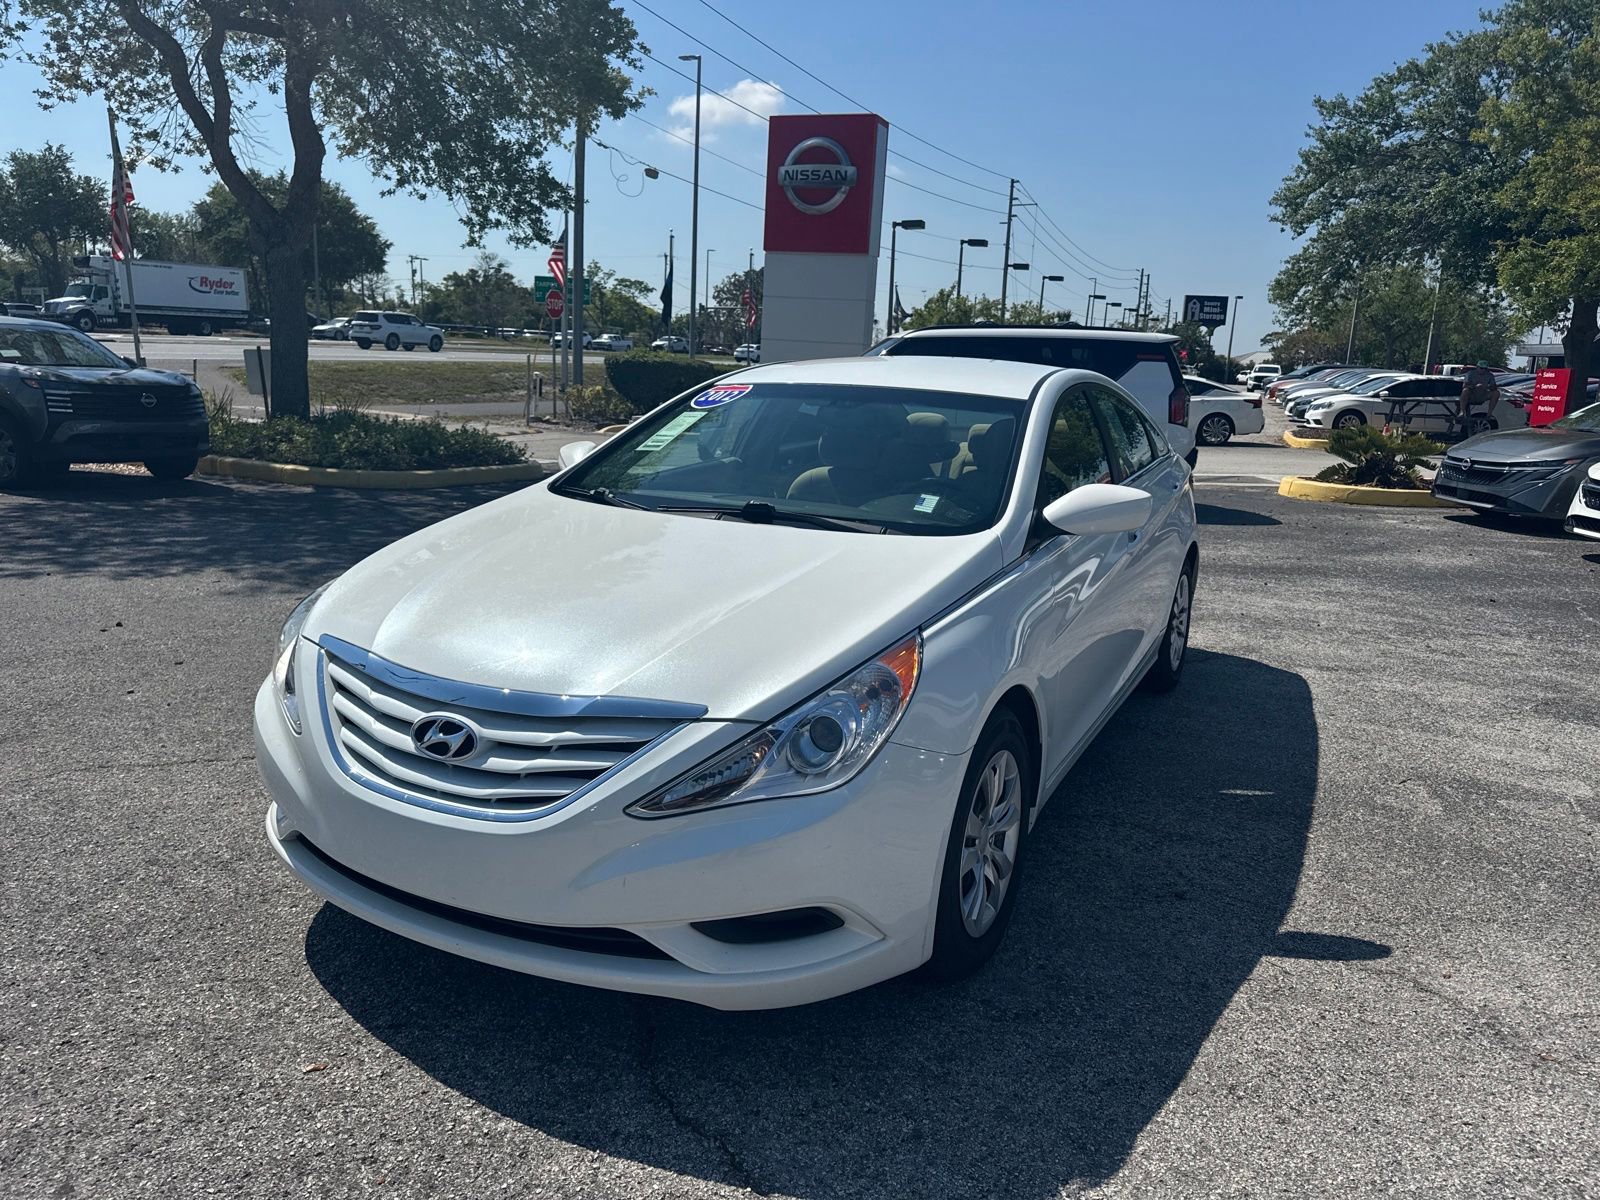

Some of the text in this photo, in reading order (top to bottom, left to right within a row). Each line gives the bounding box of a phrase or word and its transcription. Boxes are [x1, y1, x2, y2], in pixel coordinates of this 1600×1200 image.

[783, 169, 848, 182] NISSAN
[200, 275, 235, 290] Ryder
[547, 298, 563, 310] STOP
[1199, 312, 1225, 321] Storage
[696, 391, 740, 401] 2012
[1537, 405, 1555, 413] Parking
